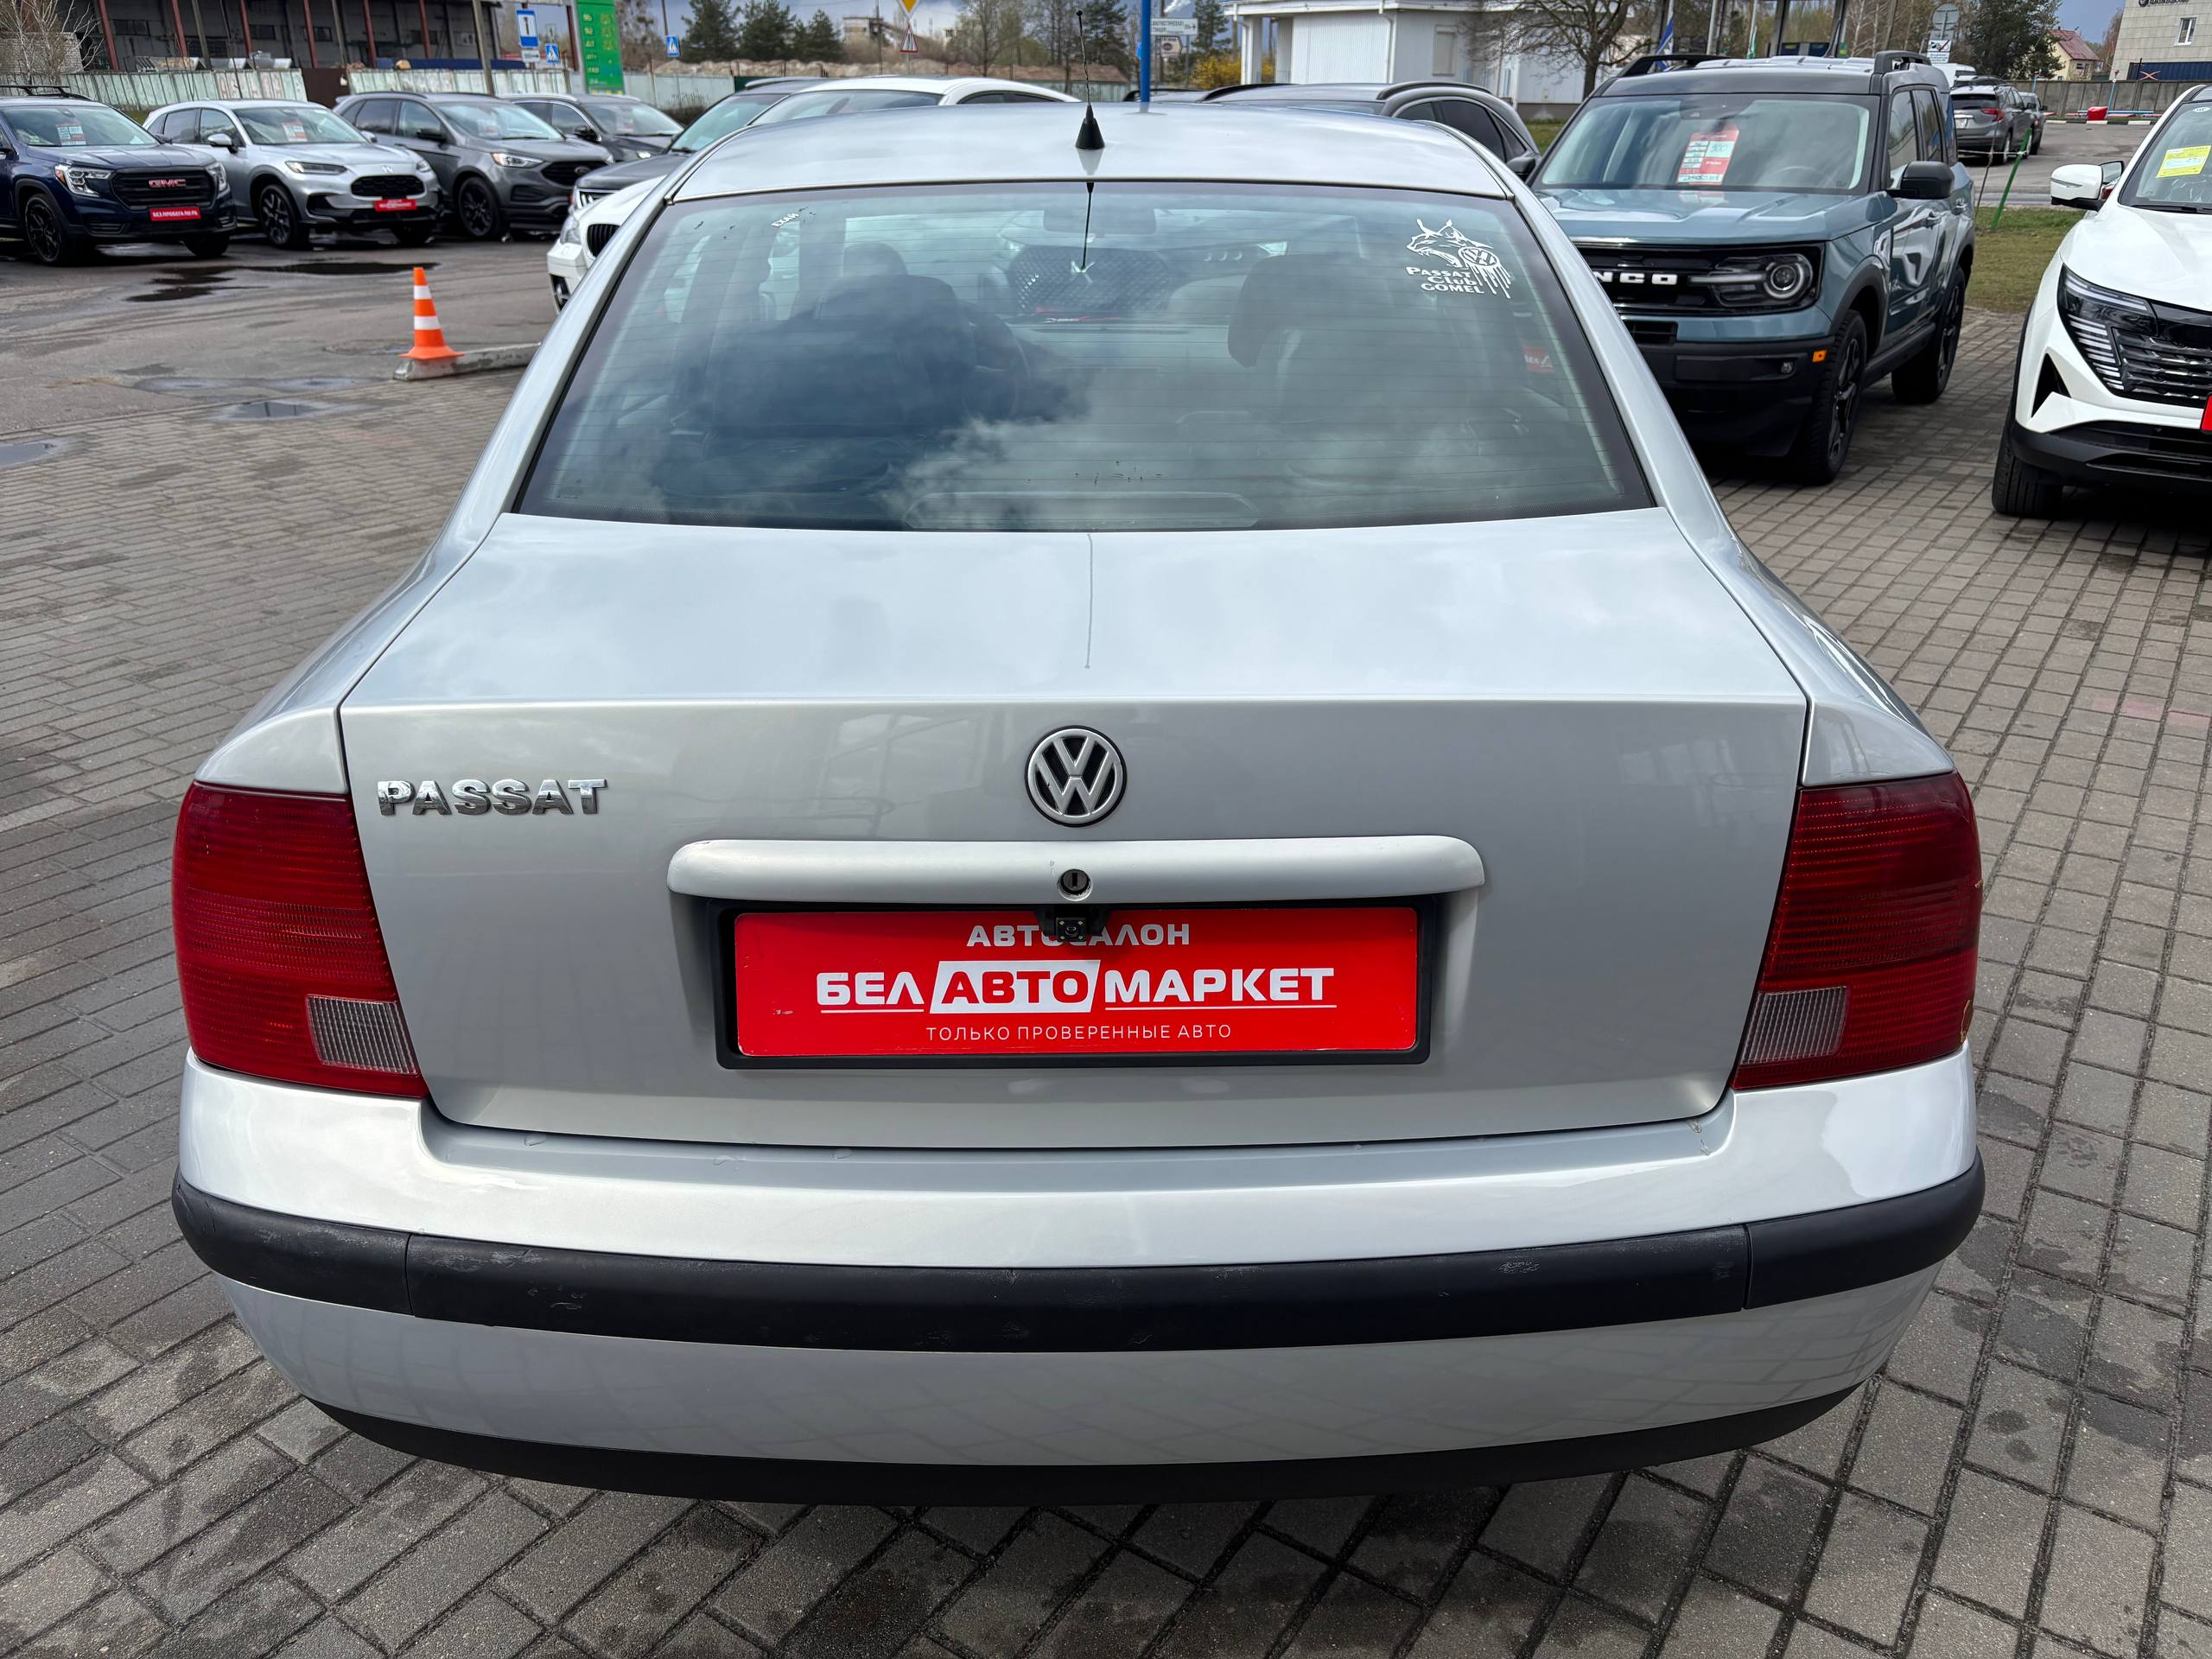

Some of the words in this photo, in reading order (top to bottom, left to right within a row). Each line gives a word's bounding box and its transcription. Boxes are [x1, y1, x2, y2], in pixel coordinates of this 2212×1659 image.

[149, 179, 186, 188] GMC
[1405, 266, 1471, 278] PASSAT
[377, 779, 608, 816] PASSAT
[966, 924, 1190, 947] АВТАЛОН
[925, 1026, 1011, 1041] ТОЛЬКО
[1017, 1024, 1171, 1040] ПРОВЕРЕННЫЕ
[1177, 1023, 1232, 1039] АВТО
